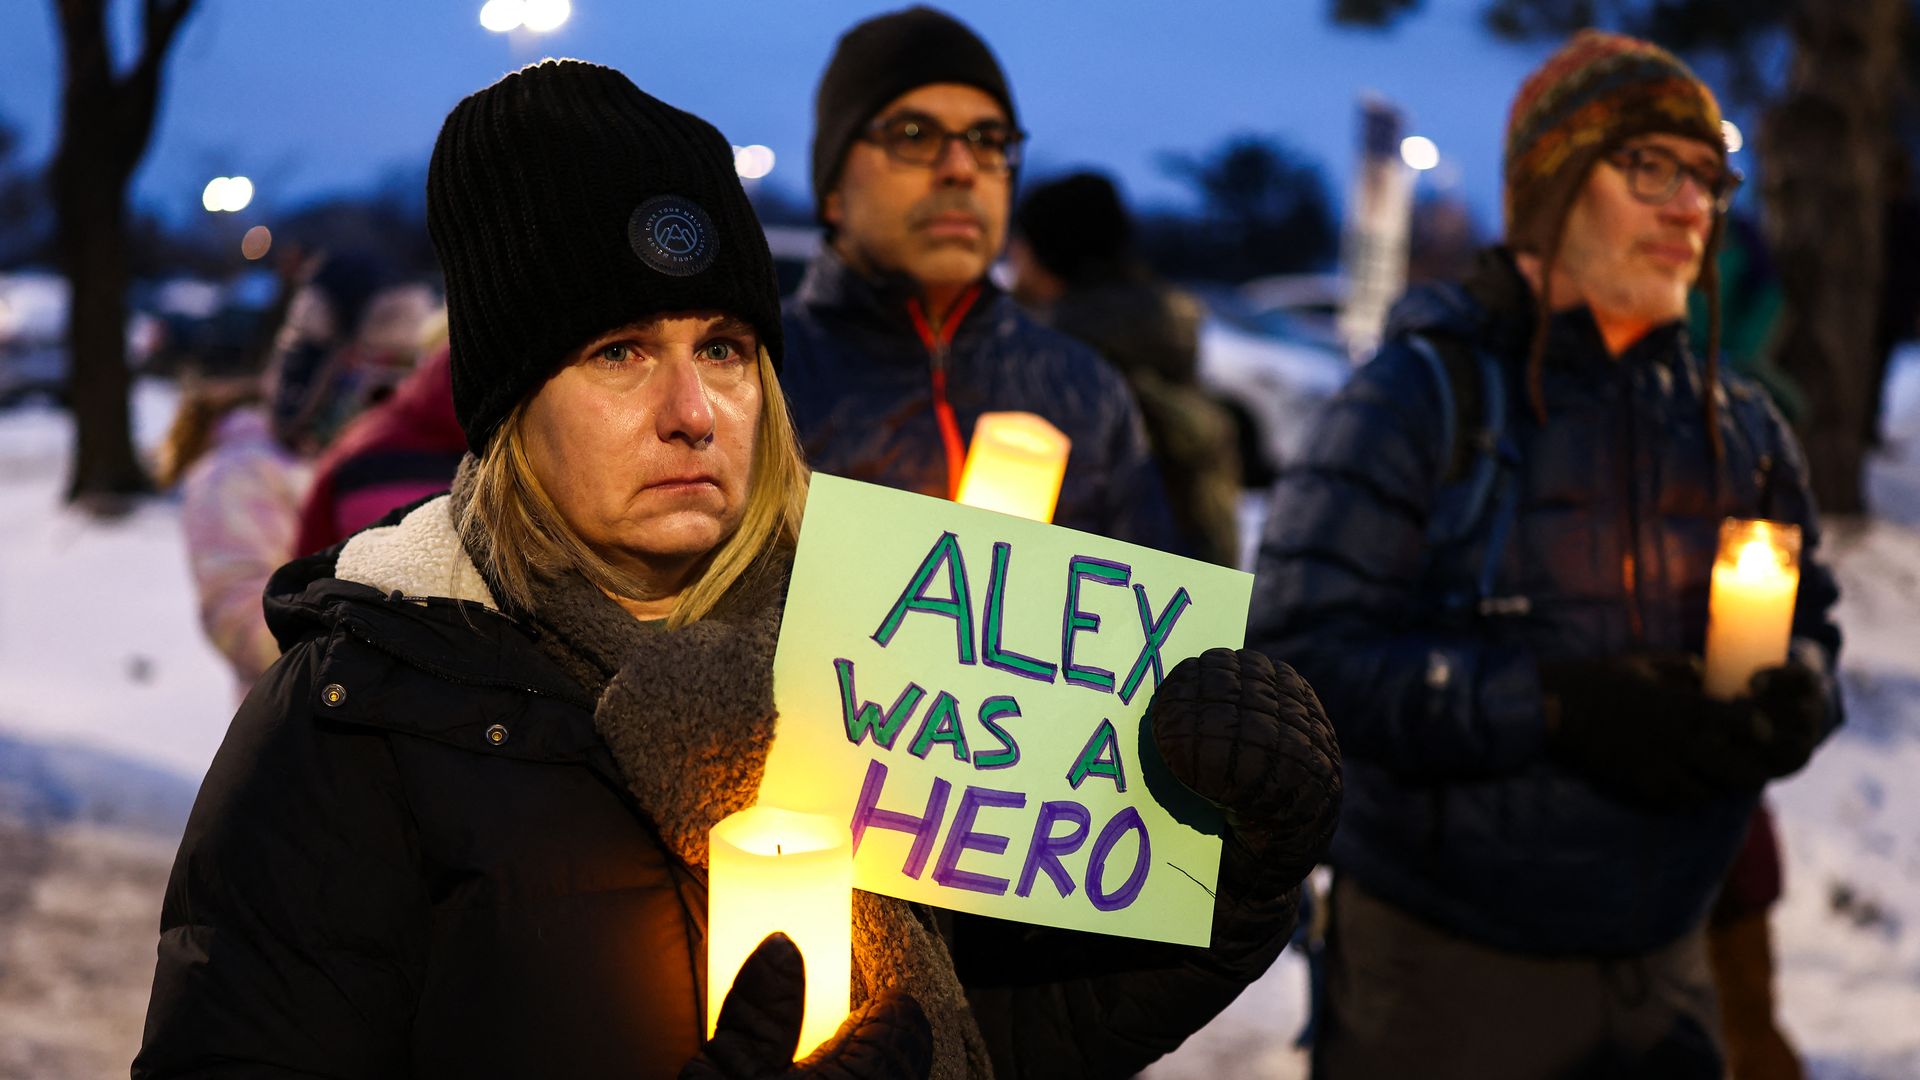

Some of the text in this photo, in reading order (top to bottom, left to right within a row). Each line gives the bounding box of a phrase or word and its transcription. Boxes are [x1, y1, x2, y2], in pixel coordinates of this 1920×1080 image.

[869, 531, 1192, 706] ALEX
[833, 658, 1127, 793] WAS A
[850, 758, 1151, 912] HERO
